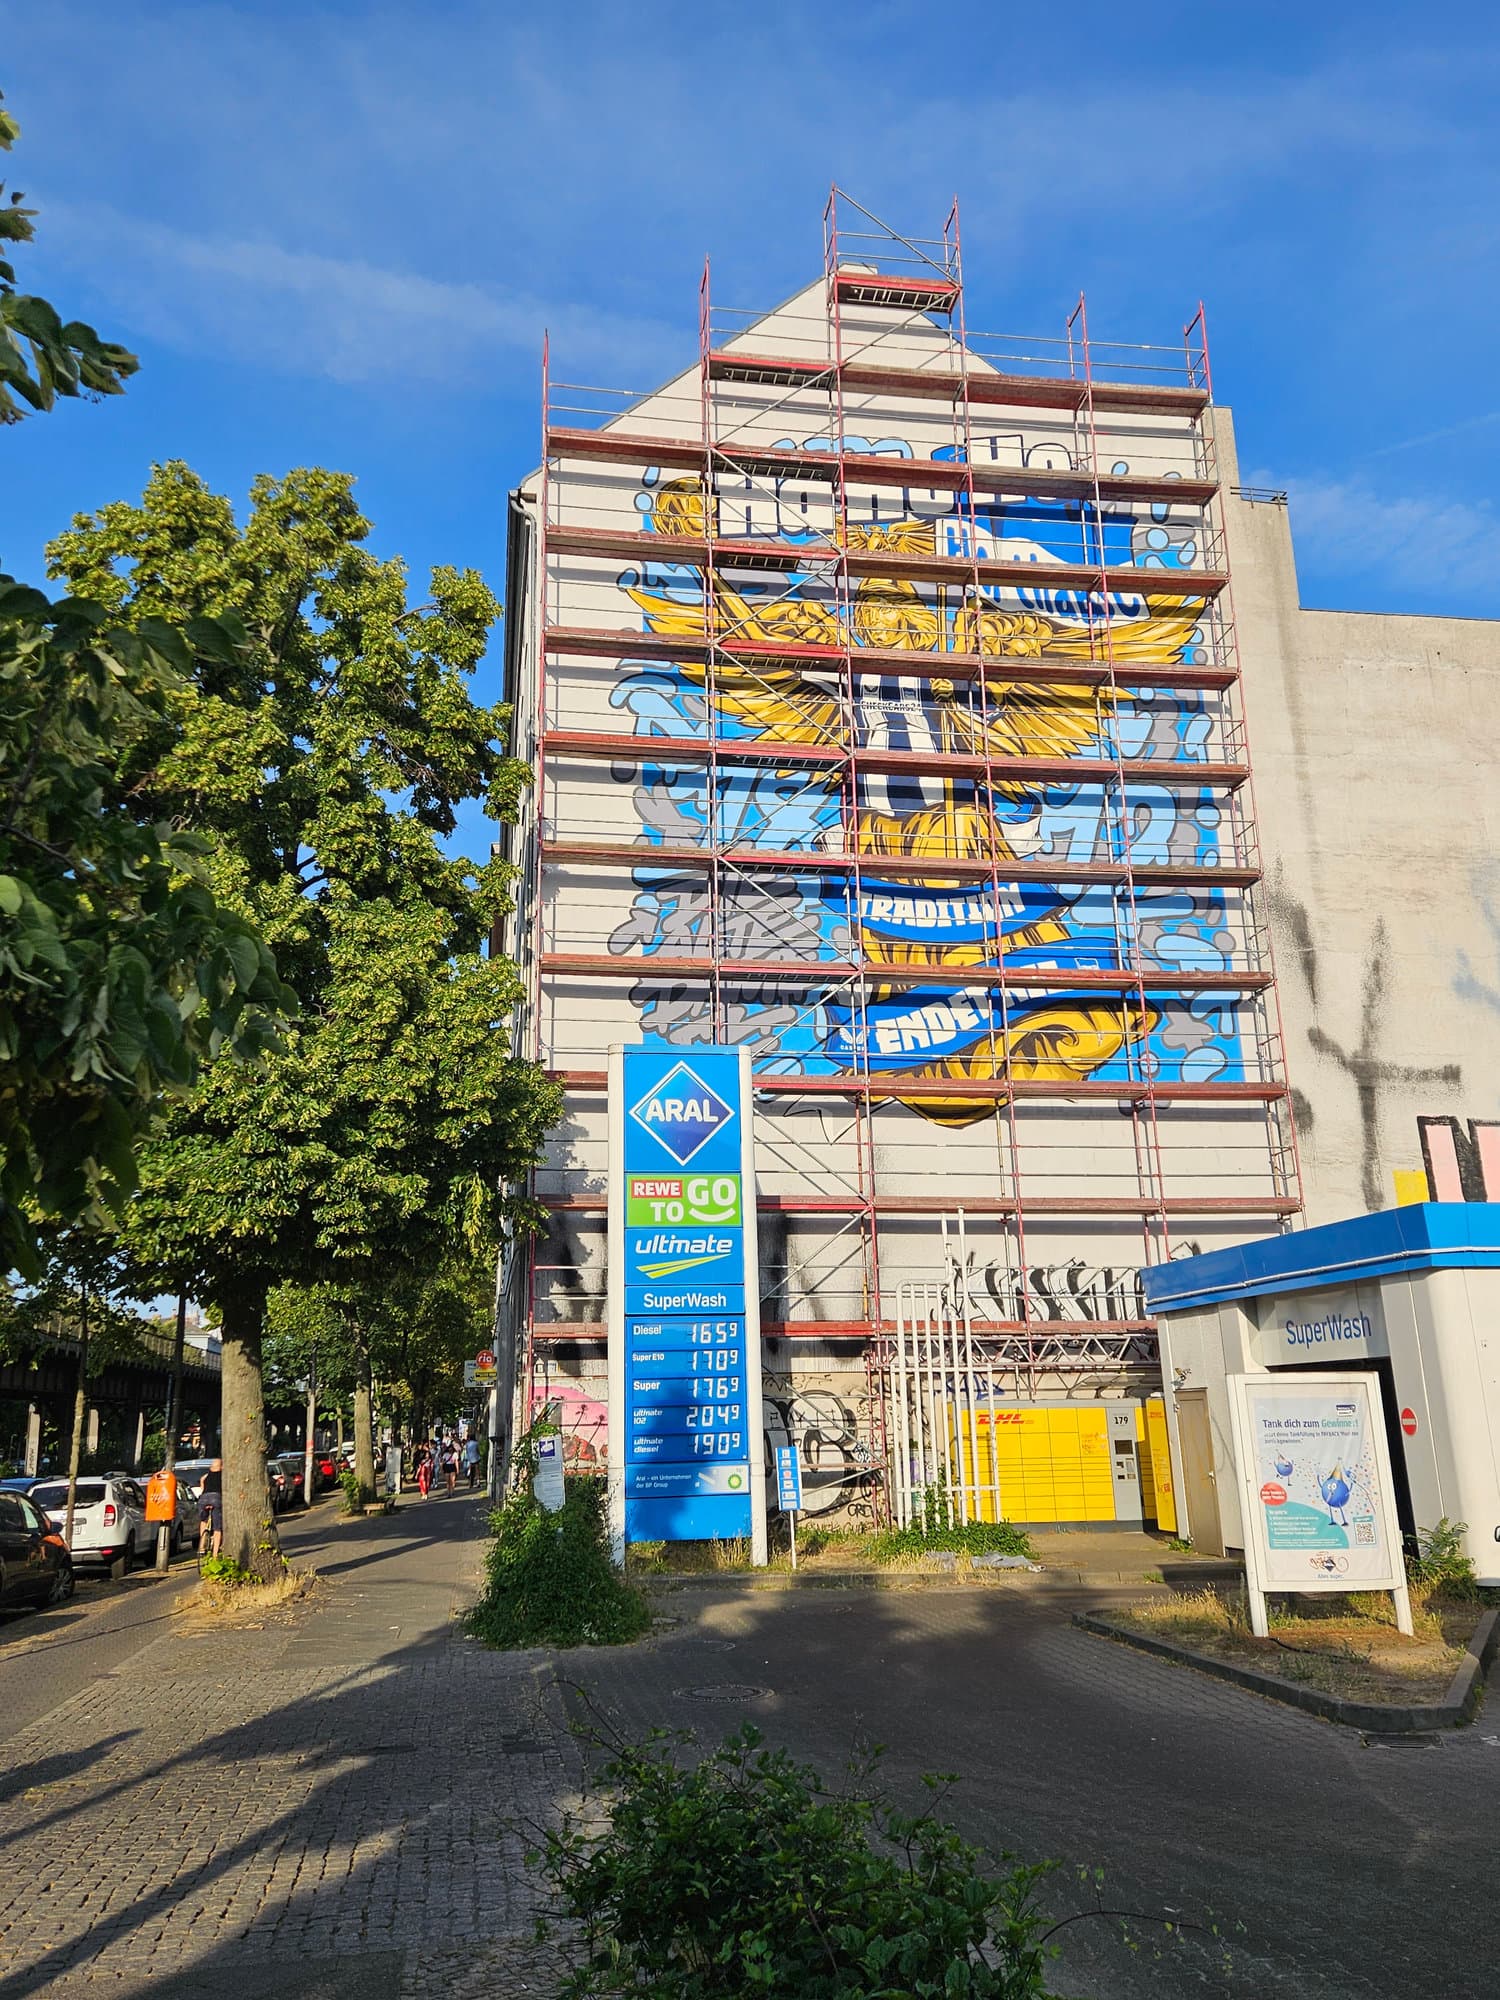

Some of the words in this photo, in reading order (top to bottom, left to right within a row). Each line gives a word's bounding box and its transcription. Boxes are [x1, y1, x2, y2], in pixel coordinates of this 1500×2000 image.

[858, 881, 1026, 928] TRADITION
[874, 985, 994, 1054] ENDET
[645, 1099, 719, 1122] ARAL
[633, 1182, 681, 1197] REWE
[650, 1201, 684, 1222] TO
[687, 1178, 737, 1207] GO
[635, 1234, 733, 1254] ultimate
[643, 1292, 727, 1310] SuperWash
[633, 1325, 662, 1335] Diesel
[691, 1322, 738, 1344] 1659
[1285, 1311, 1372, 1349] SuperWash
[632, 1352, 652, 1362] Super
[652, 1352, 665, 1361] E10
[692, 1349, 739, 1371] 1709
[633, 1380, 661, 1391] Super
[693, 1377, 739, 1399] 1769
[633, 1409, 663, 1417] ultimate
[686, 1404, 740, 1427] 2049
[633, 1417, 647, 1425] 102
[978, 1413, 1025, 1425] DHL
[1114, 1416, 1129, 1425] 179
[1262, 1419, 1282, 1428] Tank
[1284, 1419, 1301, 1428] dich
[1303, 1420, 1320, 1428] zum
[633, 1437, 664, 1445] ultimate
[693, 1432, 741, 1455] 1909
[633, 1446, 660, 1454] diesel
